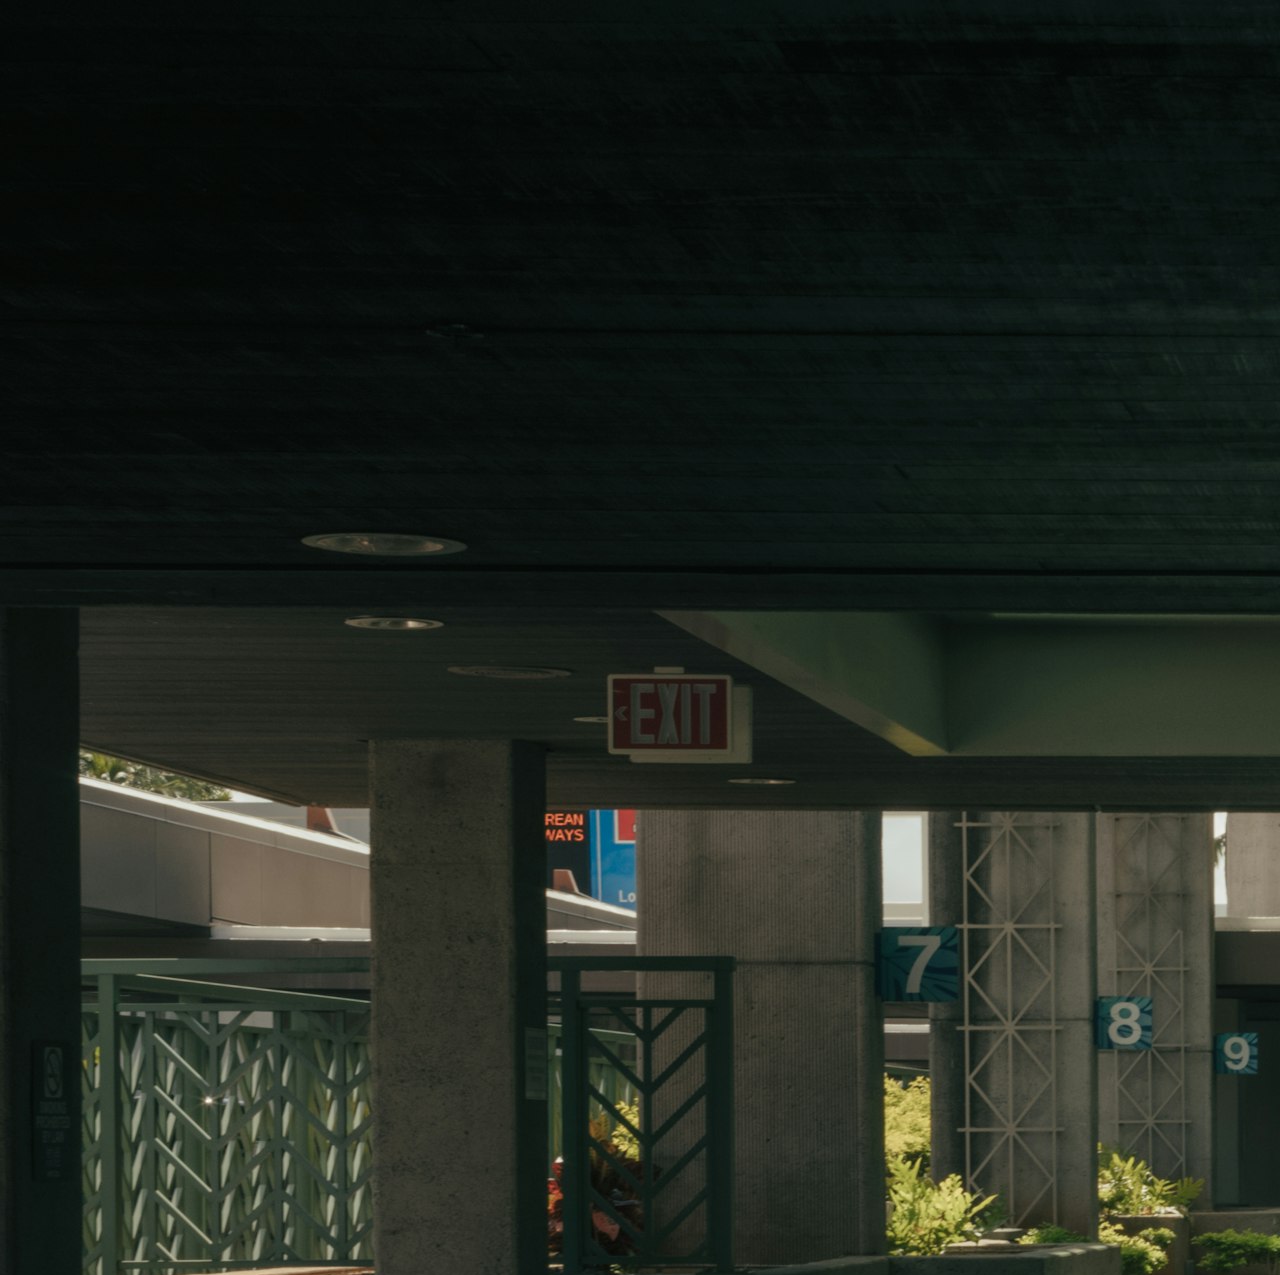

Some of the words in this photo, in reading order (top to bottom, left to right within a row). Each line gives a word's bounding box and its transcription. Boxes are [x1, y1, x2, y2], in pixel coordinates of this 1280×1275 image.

[630, 683, 717, 745] EXIT
[897, 935, 941, 994] 7
[1107, 1001, 1142, 1046] 8
[1223, 1036, 1251, 1071] 9
